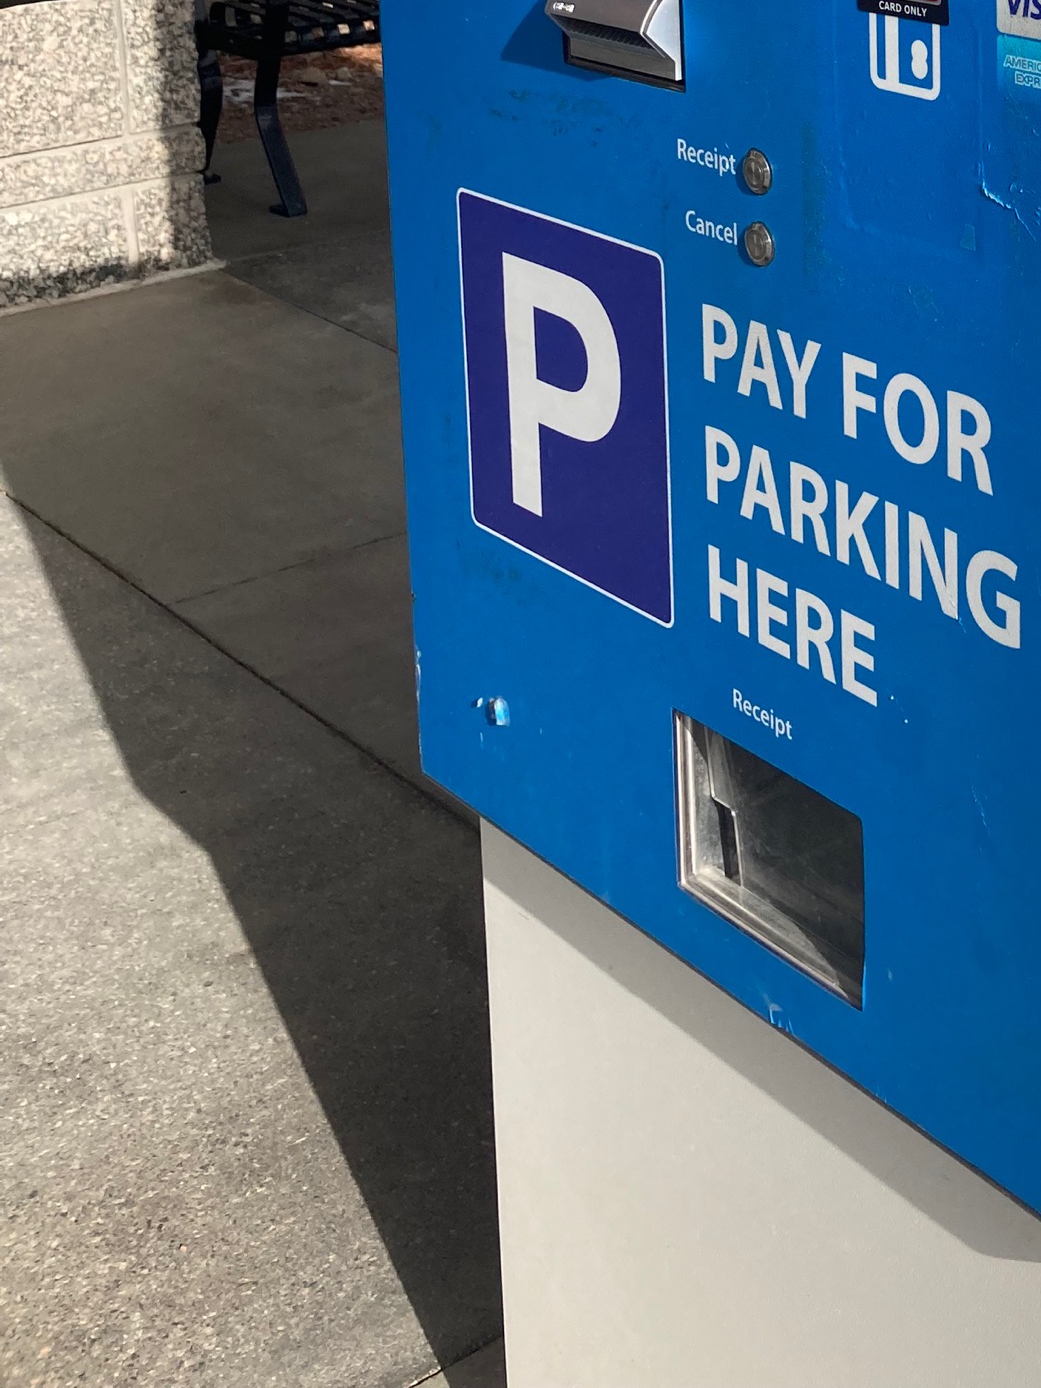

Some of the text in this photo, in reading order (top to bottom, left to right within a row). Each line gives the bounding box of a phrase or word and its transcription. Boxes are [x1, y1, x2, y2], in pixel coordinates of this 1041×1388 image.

[878, 0, 927, 17] CARD ONLY
[677, 138, 736, 177] Receipt
[685, 210, 738, 246] Cancel
[701, 303, 994, 496] PAY FOR
[705, 425, 1022, 650] PARKING
[707, 544, 878, 707] HERE
[732, 688, 793, 740] Receipt
